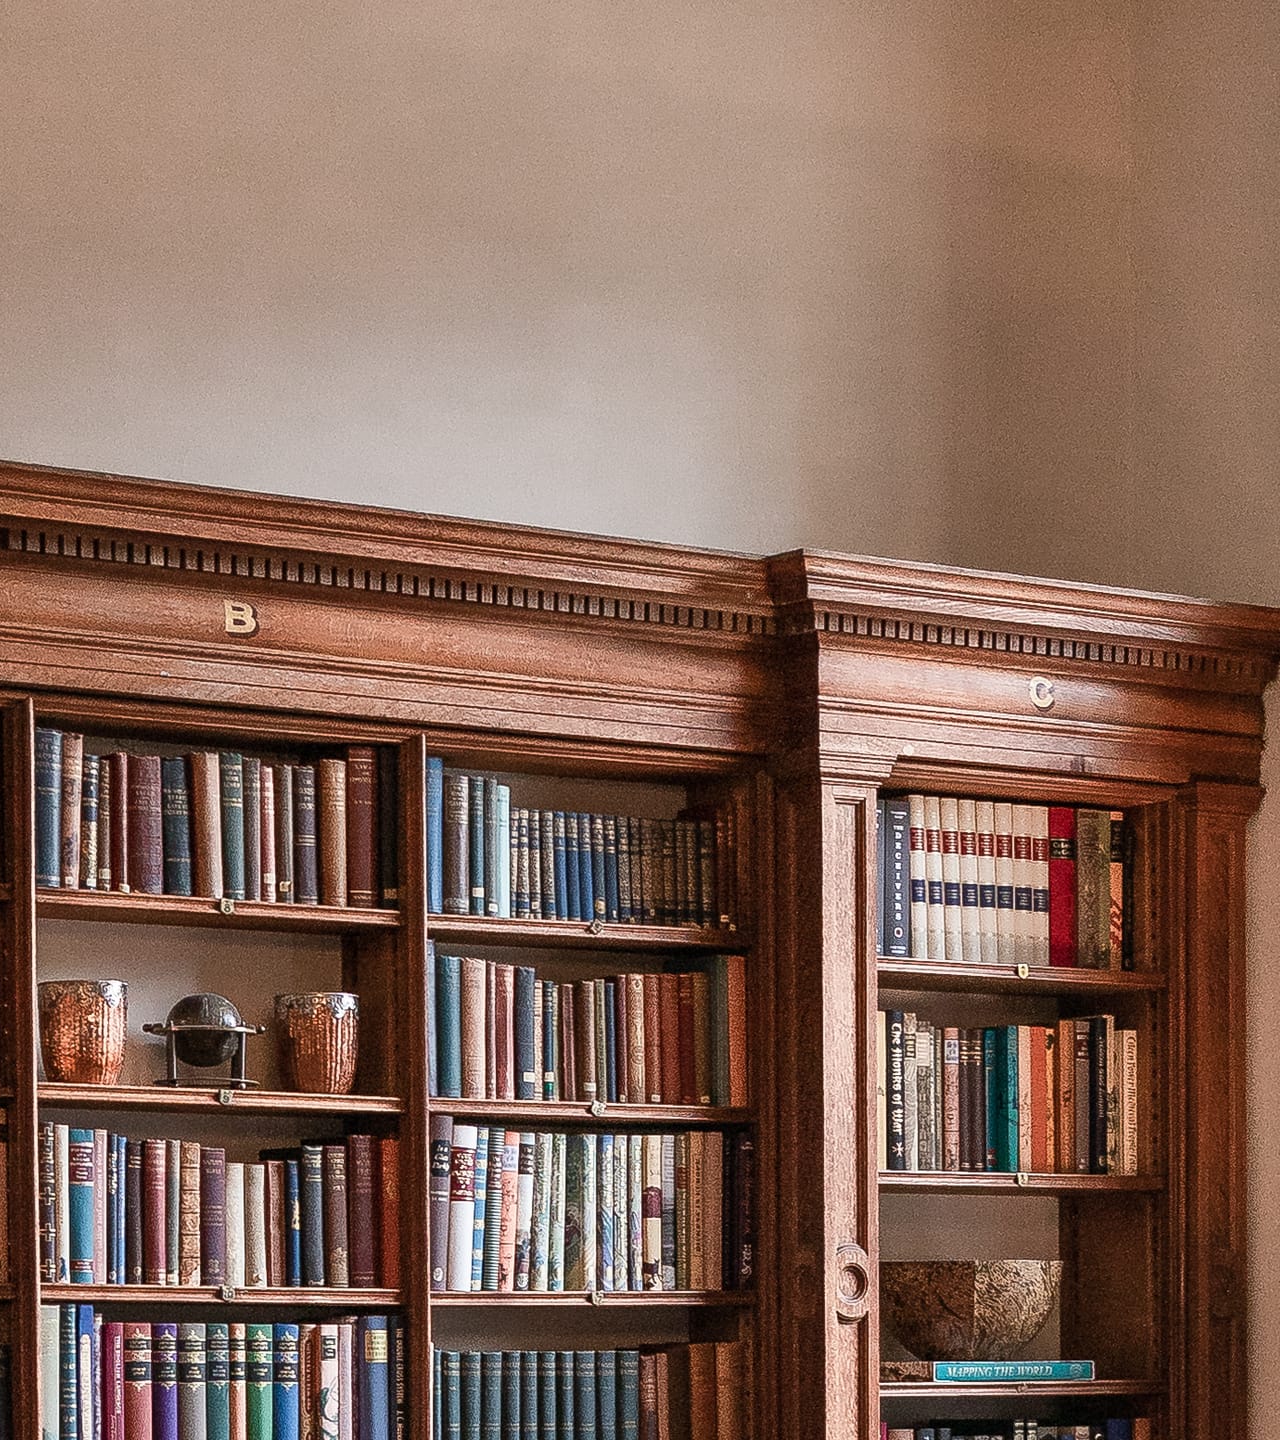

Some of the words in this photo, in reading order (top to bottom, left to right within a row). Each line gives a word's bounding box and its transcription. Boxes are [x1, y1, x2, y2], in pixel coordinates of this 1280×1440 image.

[223, 600, 257, 634] B
[1029, 676, 1055, 709] C
[891, 1023, 904, 1045] The
[892, 1108, 904, 1136] War
[946, 1366, 993, 1378] MAPPING
[993, 1366, 1015, 1378] THE
[1016, 1365, 1053, 1377] WORLD
